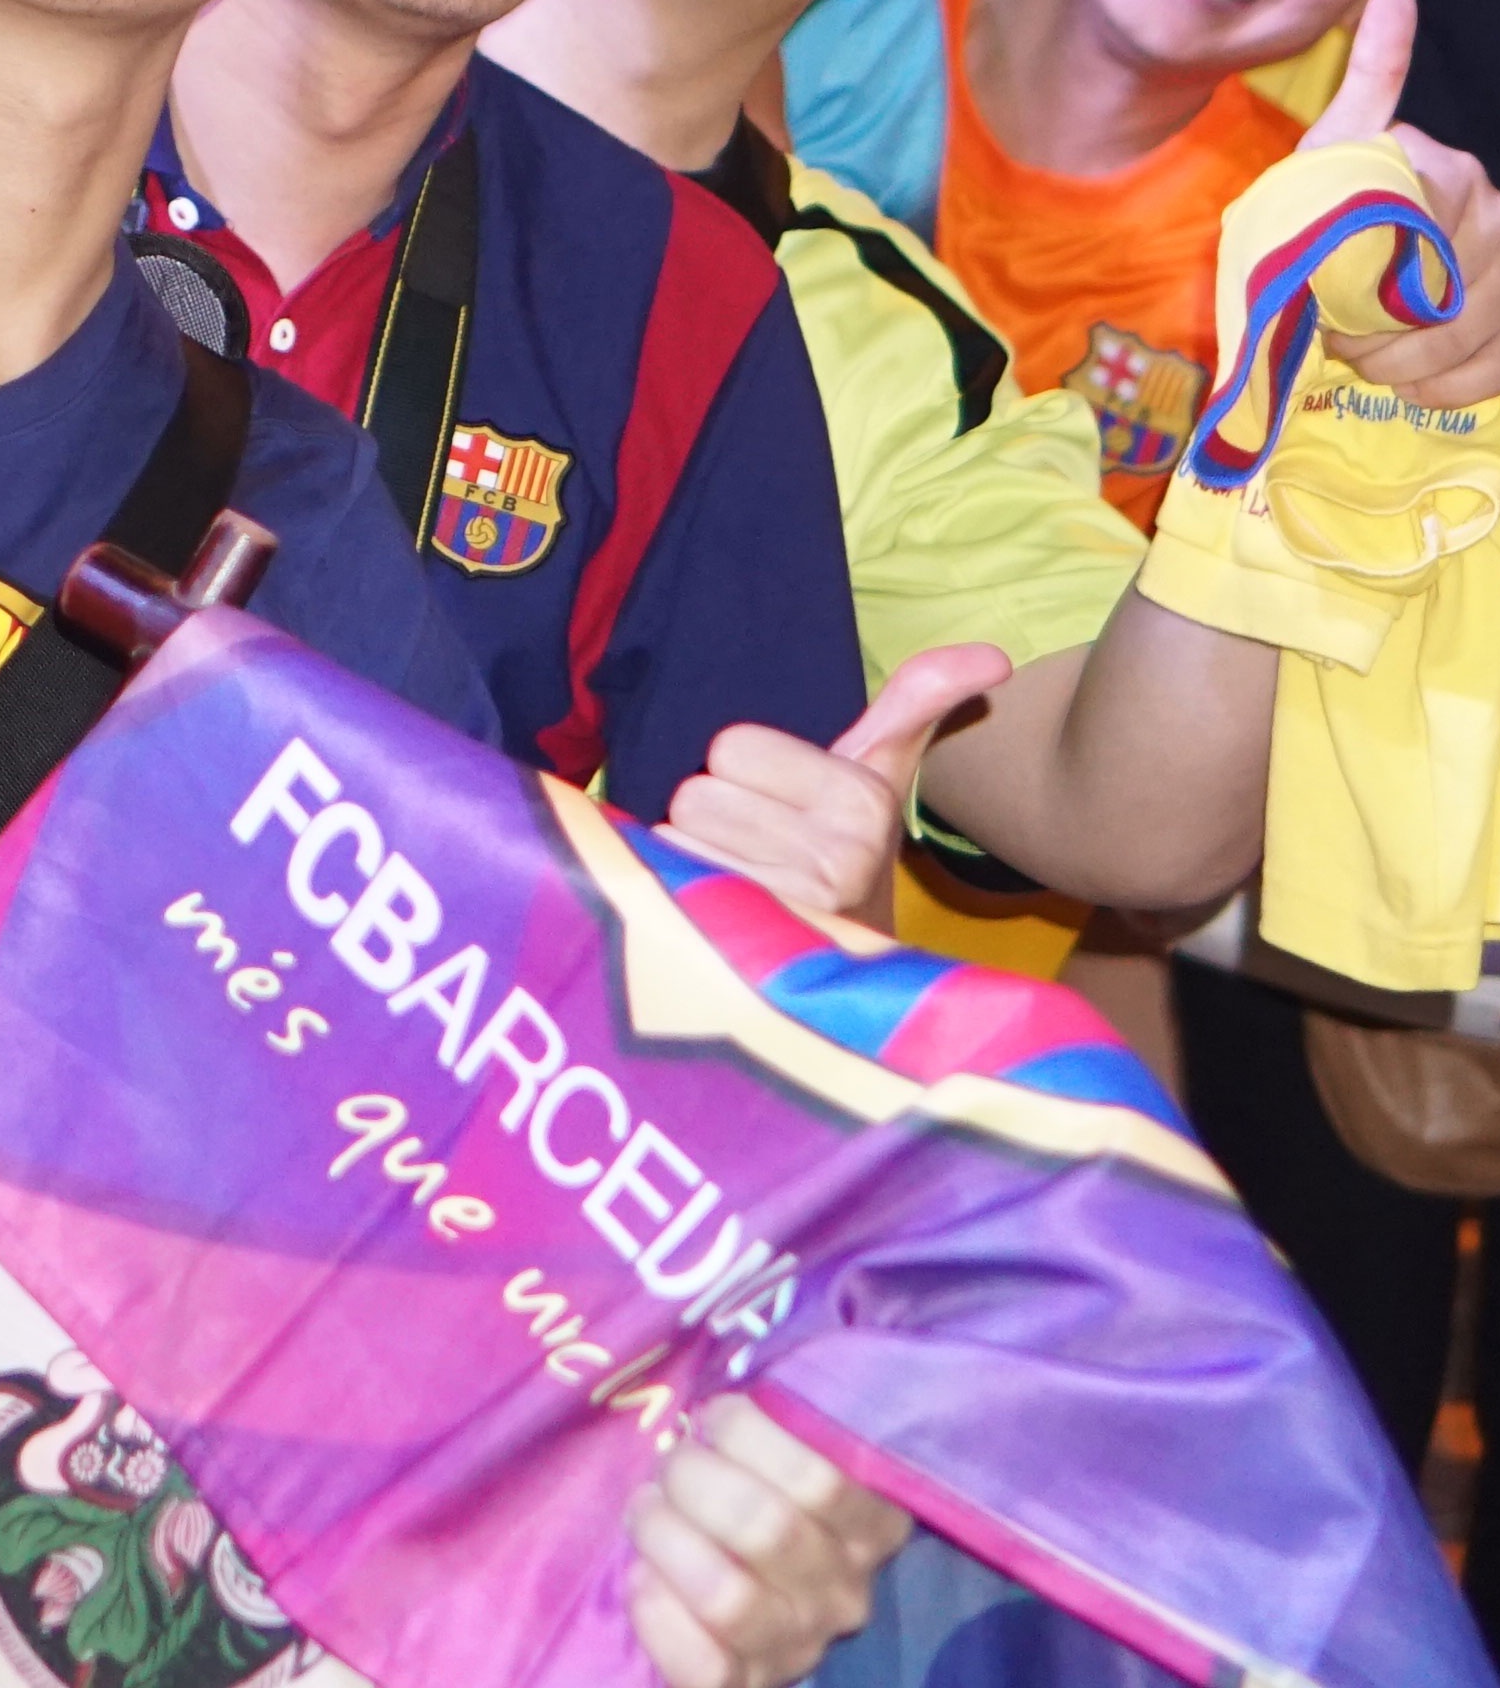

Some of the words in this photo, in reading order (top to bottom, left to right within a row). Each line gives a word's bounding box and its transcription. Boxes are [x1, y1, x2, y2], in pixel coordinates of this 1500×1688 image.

[1436, 410, 1477, 435] NAM
[463, 483, 518, 514] FCB
[163, 890, 331, 1056] més
[327, 1094, 495, 1242] que
